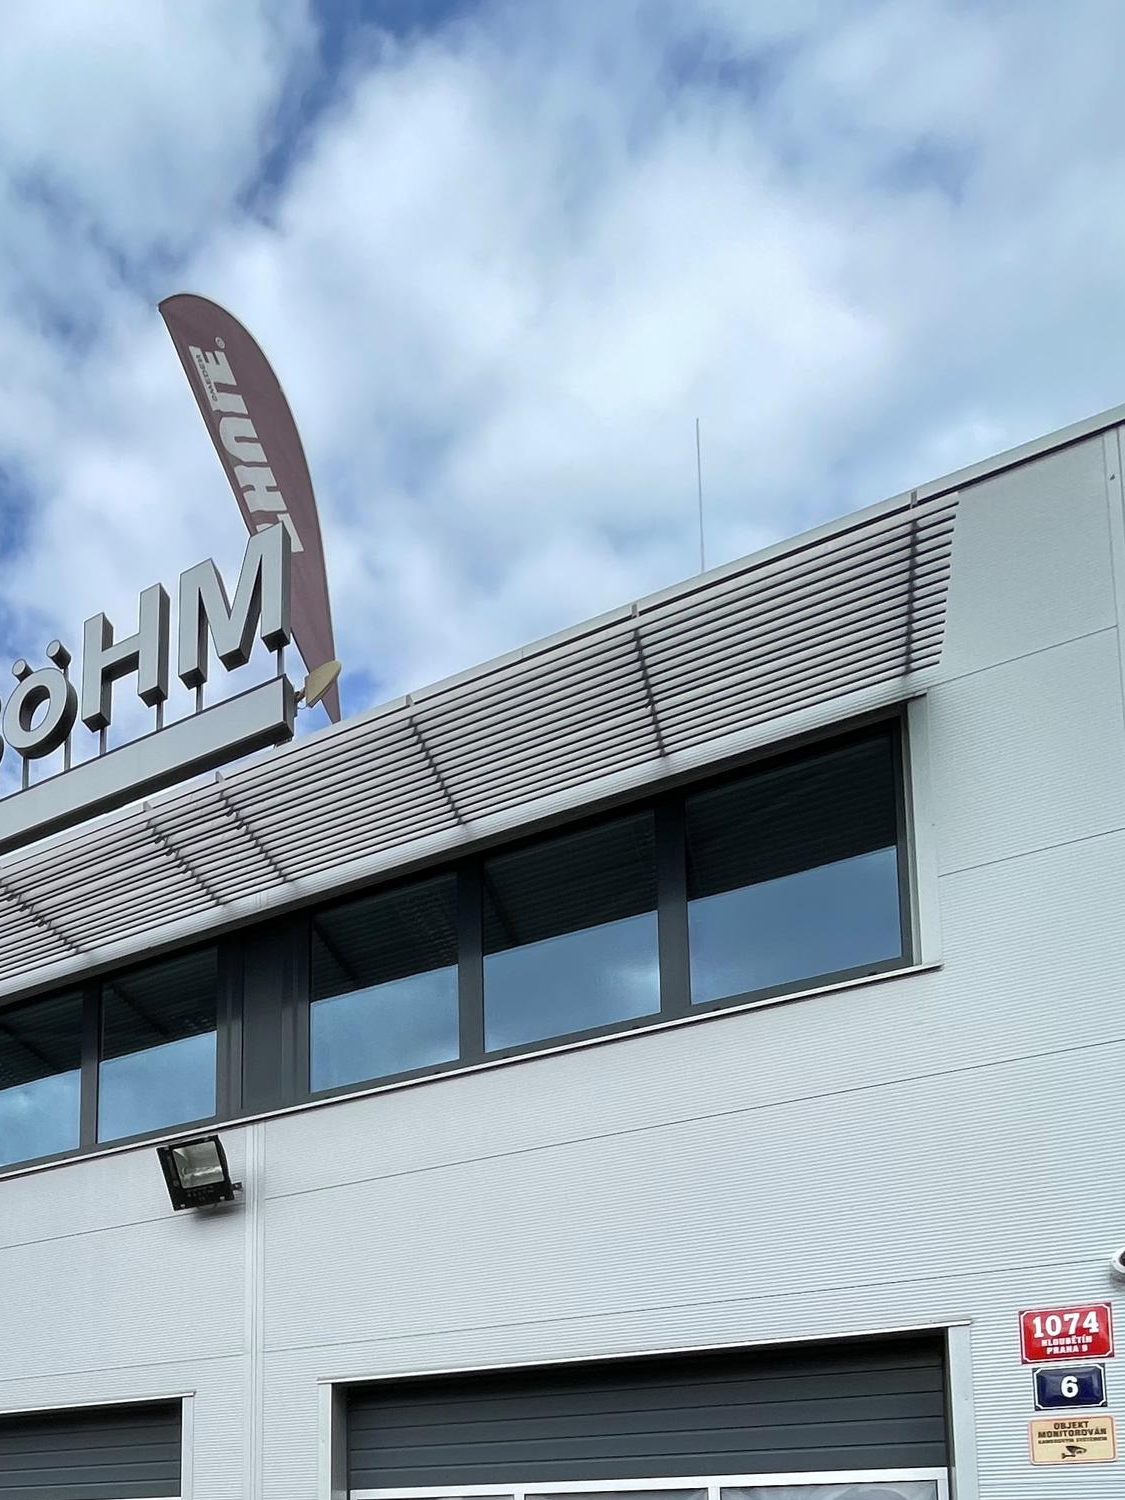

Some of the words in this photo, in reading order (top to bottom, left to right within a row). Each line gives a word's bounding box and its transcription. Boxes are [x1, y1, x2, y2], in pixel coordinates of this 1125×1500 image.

[1032, 1311, 1100, 1338] 1074
[1046, 1345, 1080, 1355] PRAHA
[1081, 1344, 1089, 1352] 9
[1060, 1375, 1079, 1399] 6
[1053, 1420, 1089, 1430] OBJEKT
[1037, 1427, 1107, 1438] MONITOROVÁN
